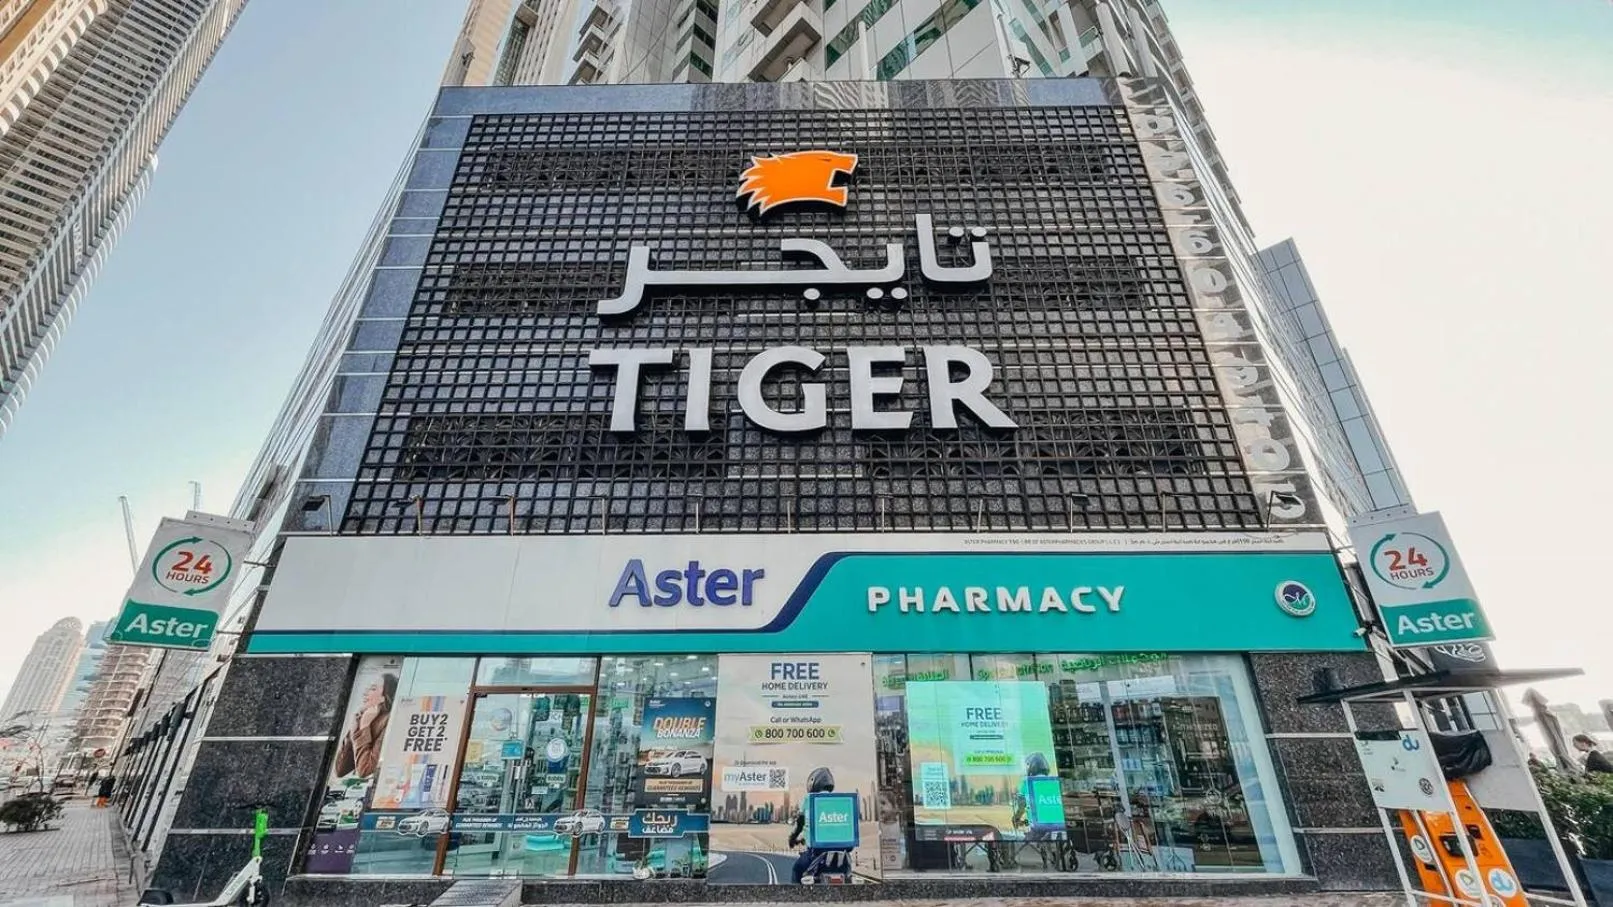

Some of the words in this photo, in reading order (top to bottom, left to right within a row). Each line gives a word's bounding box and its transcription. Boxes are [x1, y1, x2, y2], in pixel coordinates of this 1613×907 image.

[597, 213, 993, 314] تايجر
[588, 346, 1018, 432] TIGER
[171, 551, 213, 574] 24
[1383, 547, 1428, 571] 24
[166, 571, 210, 584] HOURS
[1390, 567, 1435, 581] HOURS
[608, 558, 765, 608] Aster
[867, 586, 1126, 614] PHARMACY
[124, 613, 208, 639] Aster
[1397, 612, 1476, 635] Aster
[771, 662, 820, 680] FREE
[761, 682, 787, 691] HOME
[788, 681, 829, 691] DELIVERY
[790, 716, 822, 724] WhatsApp
[966, 707, 1002, 720] FREE
[653, 716, 707, 731] DOUBLE
[408, 726, 435, 738] GET
[436, 725, 445, 738] 2
[656, 727, 704, 738] BONANZA
[765, 728, 784, 739] 800
[786, 728, 805, 739] 700
[806, 728, 825, 739] 600
[724, 771, 767, 784] myAster
[819, 811, 848, 823] Aster
